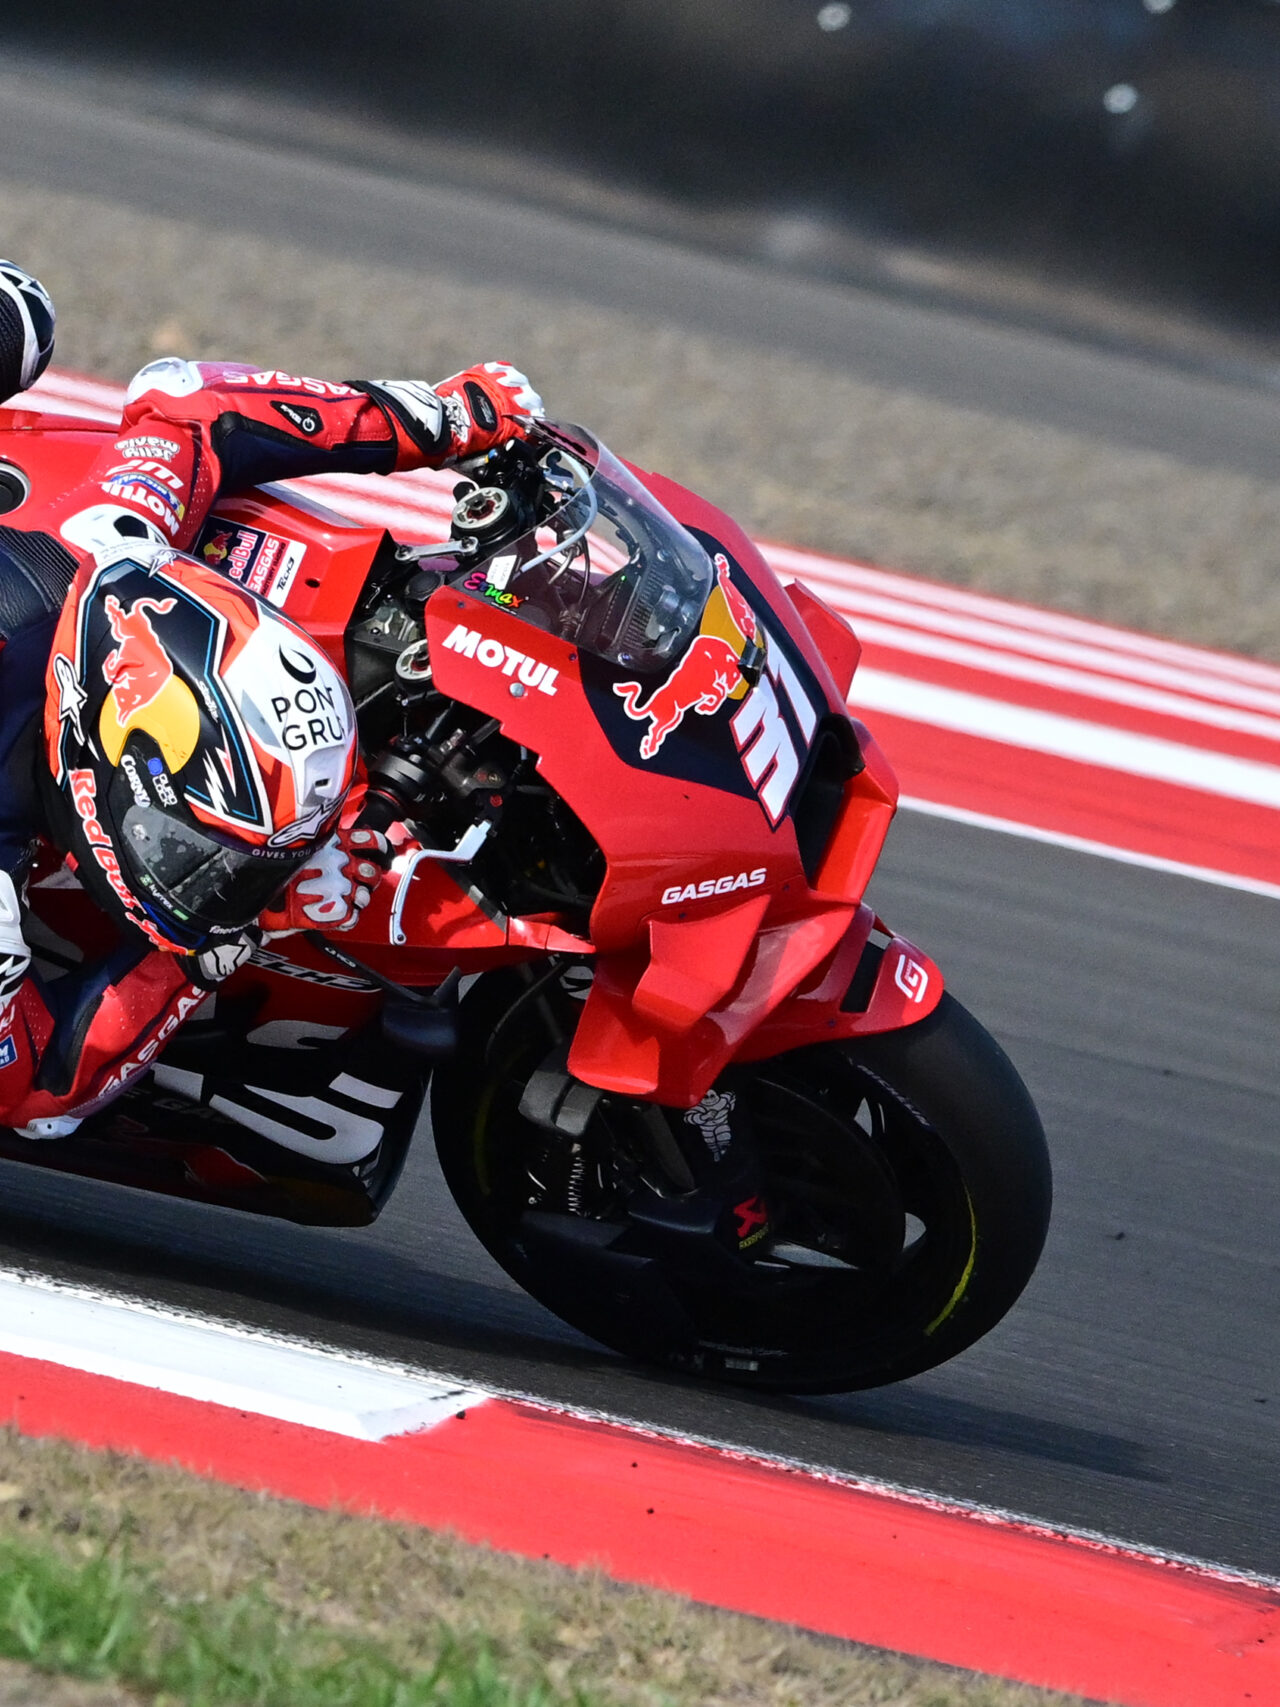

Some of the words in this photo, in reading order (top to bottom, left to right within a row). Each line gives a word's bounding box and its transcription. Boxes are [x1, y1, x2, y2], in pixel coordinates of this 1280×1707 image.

[442, 624, 561, 697] MOTUL
[120, 754, 151, 808] CORNY
[661, 867, 768, 905] GASGAS
